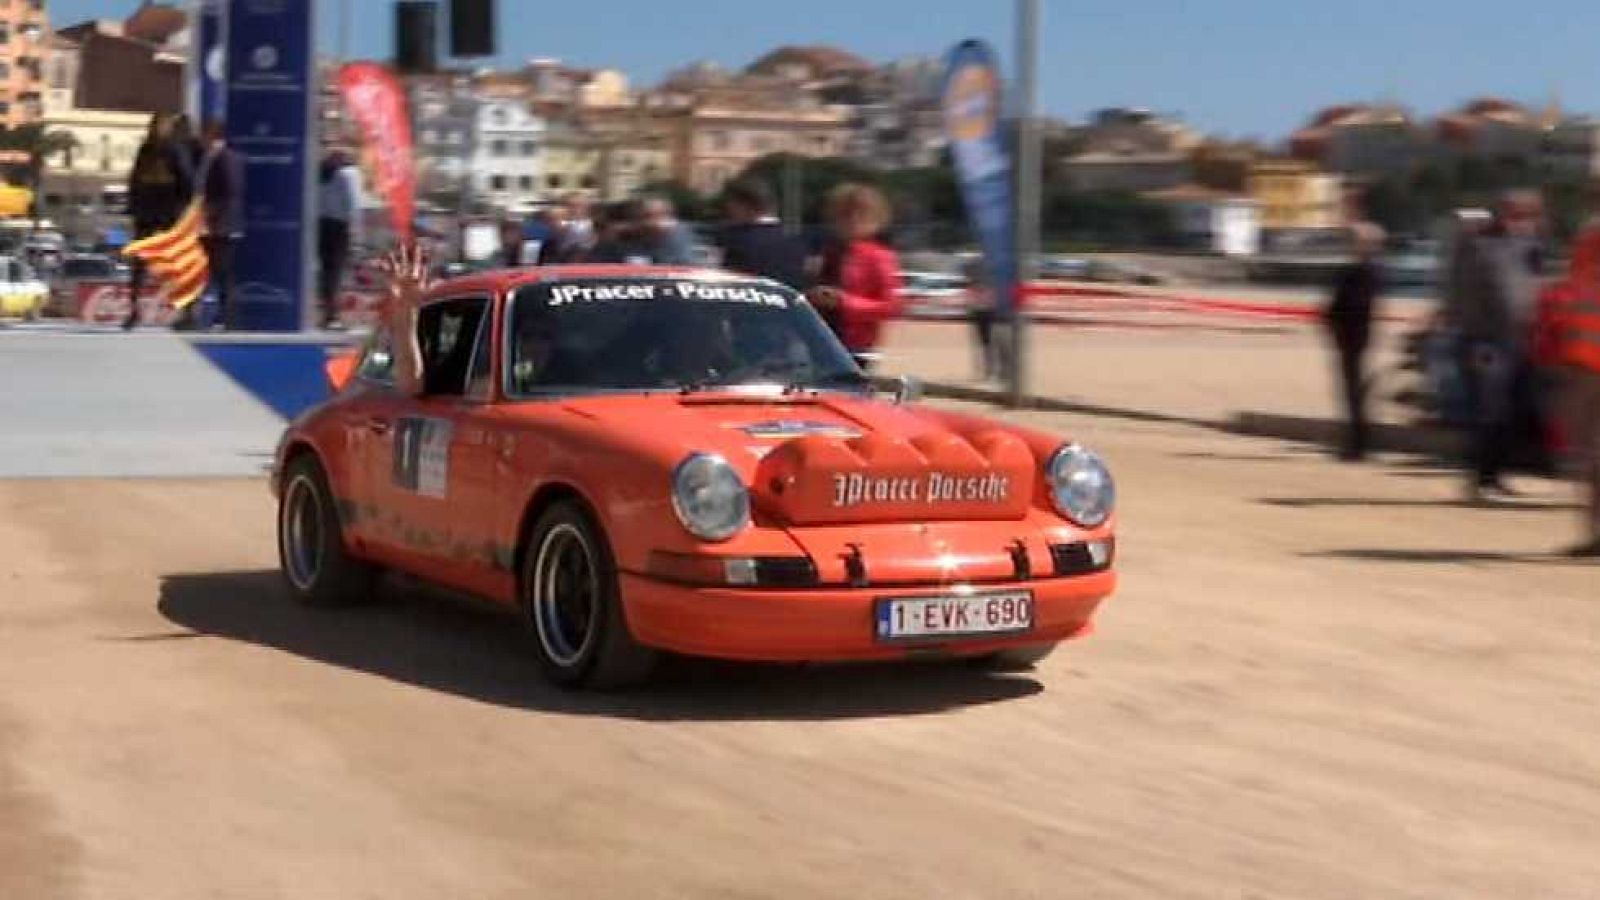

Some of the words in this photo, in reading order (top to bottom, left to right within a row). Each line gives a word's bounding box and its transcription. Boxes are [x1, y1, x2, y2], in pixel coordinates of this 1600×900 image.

[548, 284, 654, 306] JPracer
[676, 281, 788, 309] Porsche
[833, 471, 919, 507] JPracer
[927, 471, 1009, 504] Porsche
